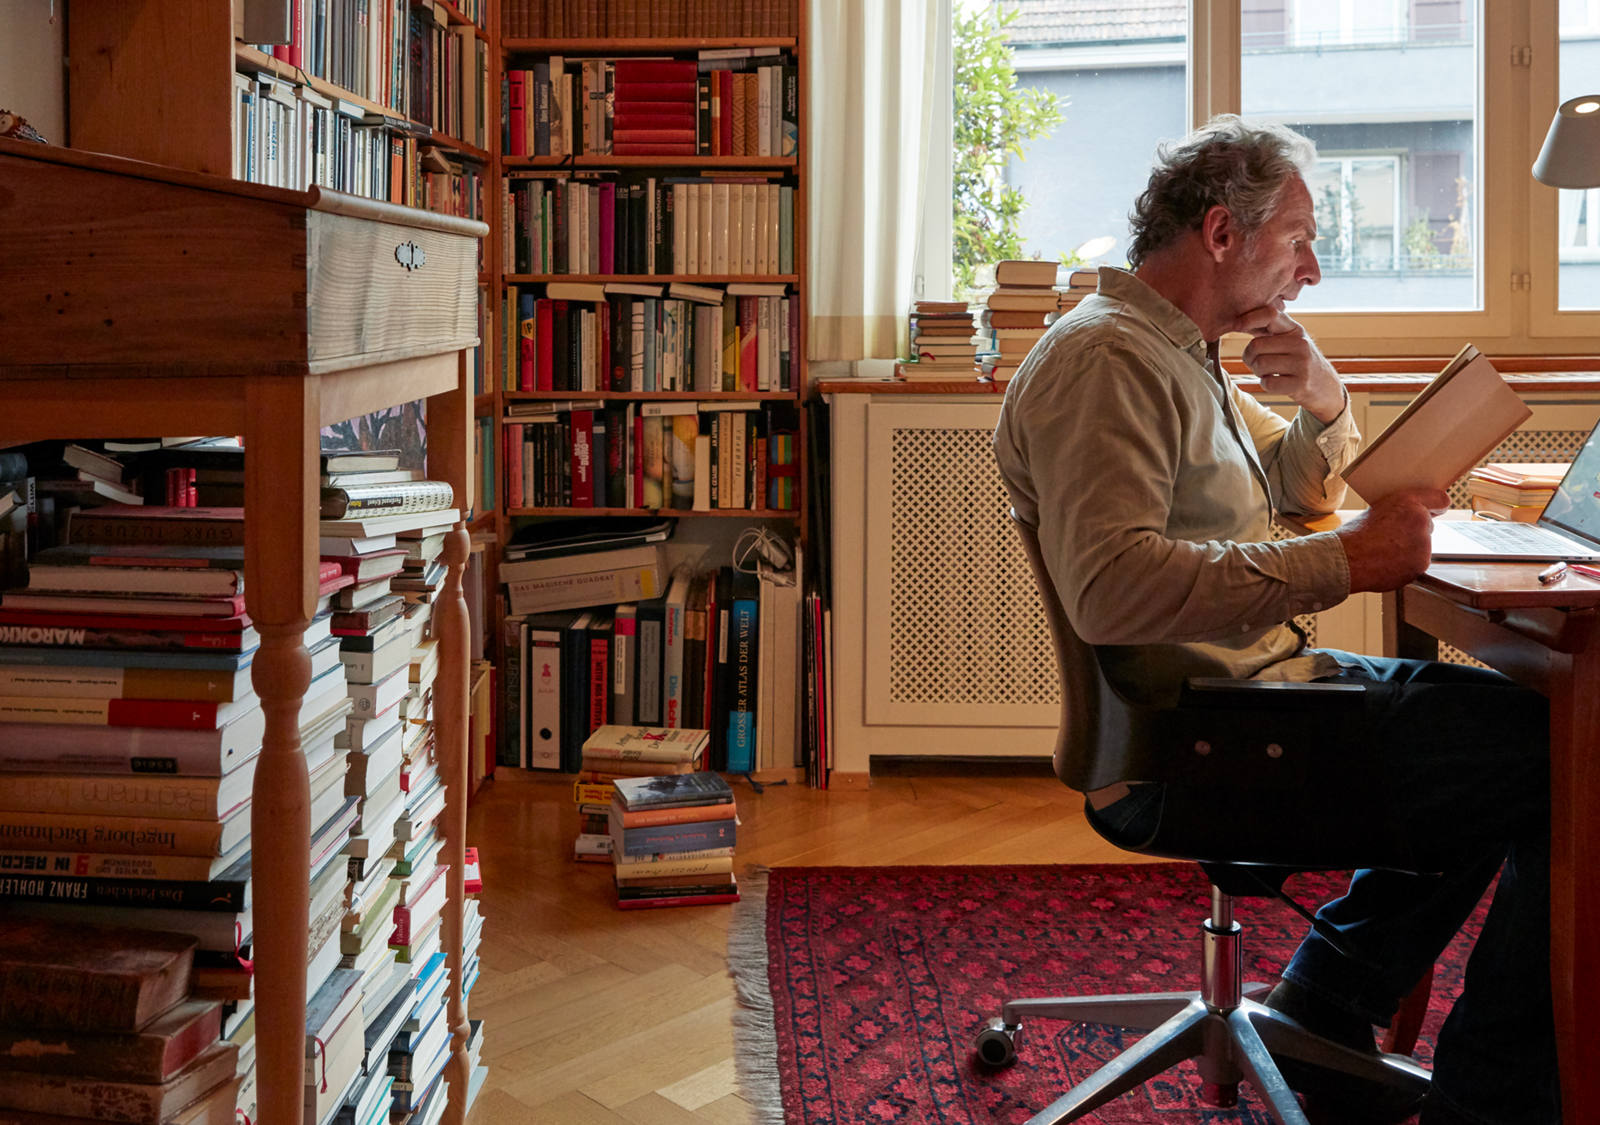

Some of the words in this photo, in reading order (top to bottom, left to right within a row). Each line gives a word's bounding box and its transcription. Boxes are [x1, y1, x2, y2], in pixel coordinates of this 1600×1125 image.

[739, 610, 750, 638] WELT
[739, 641, 749, 663] DER
[738, 665, 748, 696] ATLAS
[736, 699, 747, 747] GROSSER
[80, 782, 208, 812] Bachmann
[0, 825, 87, 850] Bachman
[95, 826, 176, 850] Ingeborg
[0, 854, 47, 870] ASCO
[54, 856, 71, 871] IN
[48, 881, 88, 899] FRANZ
[159, 888, 184, 902] Das
